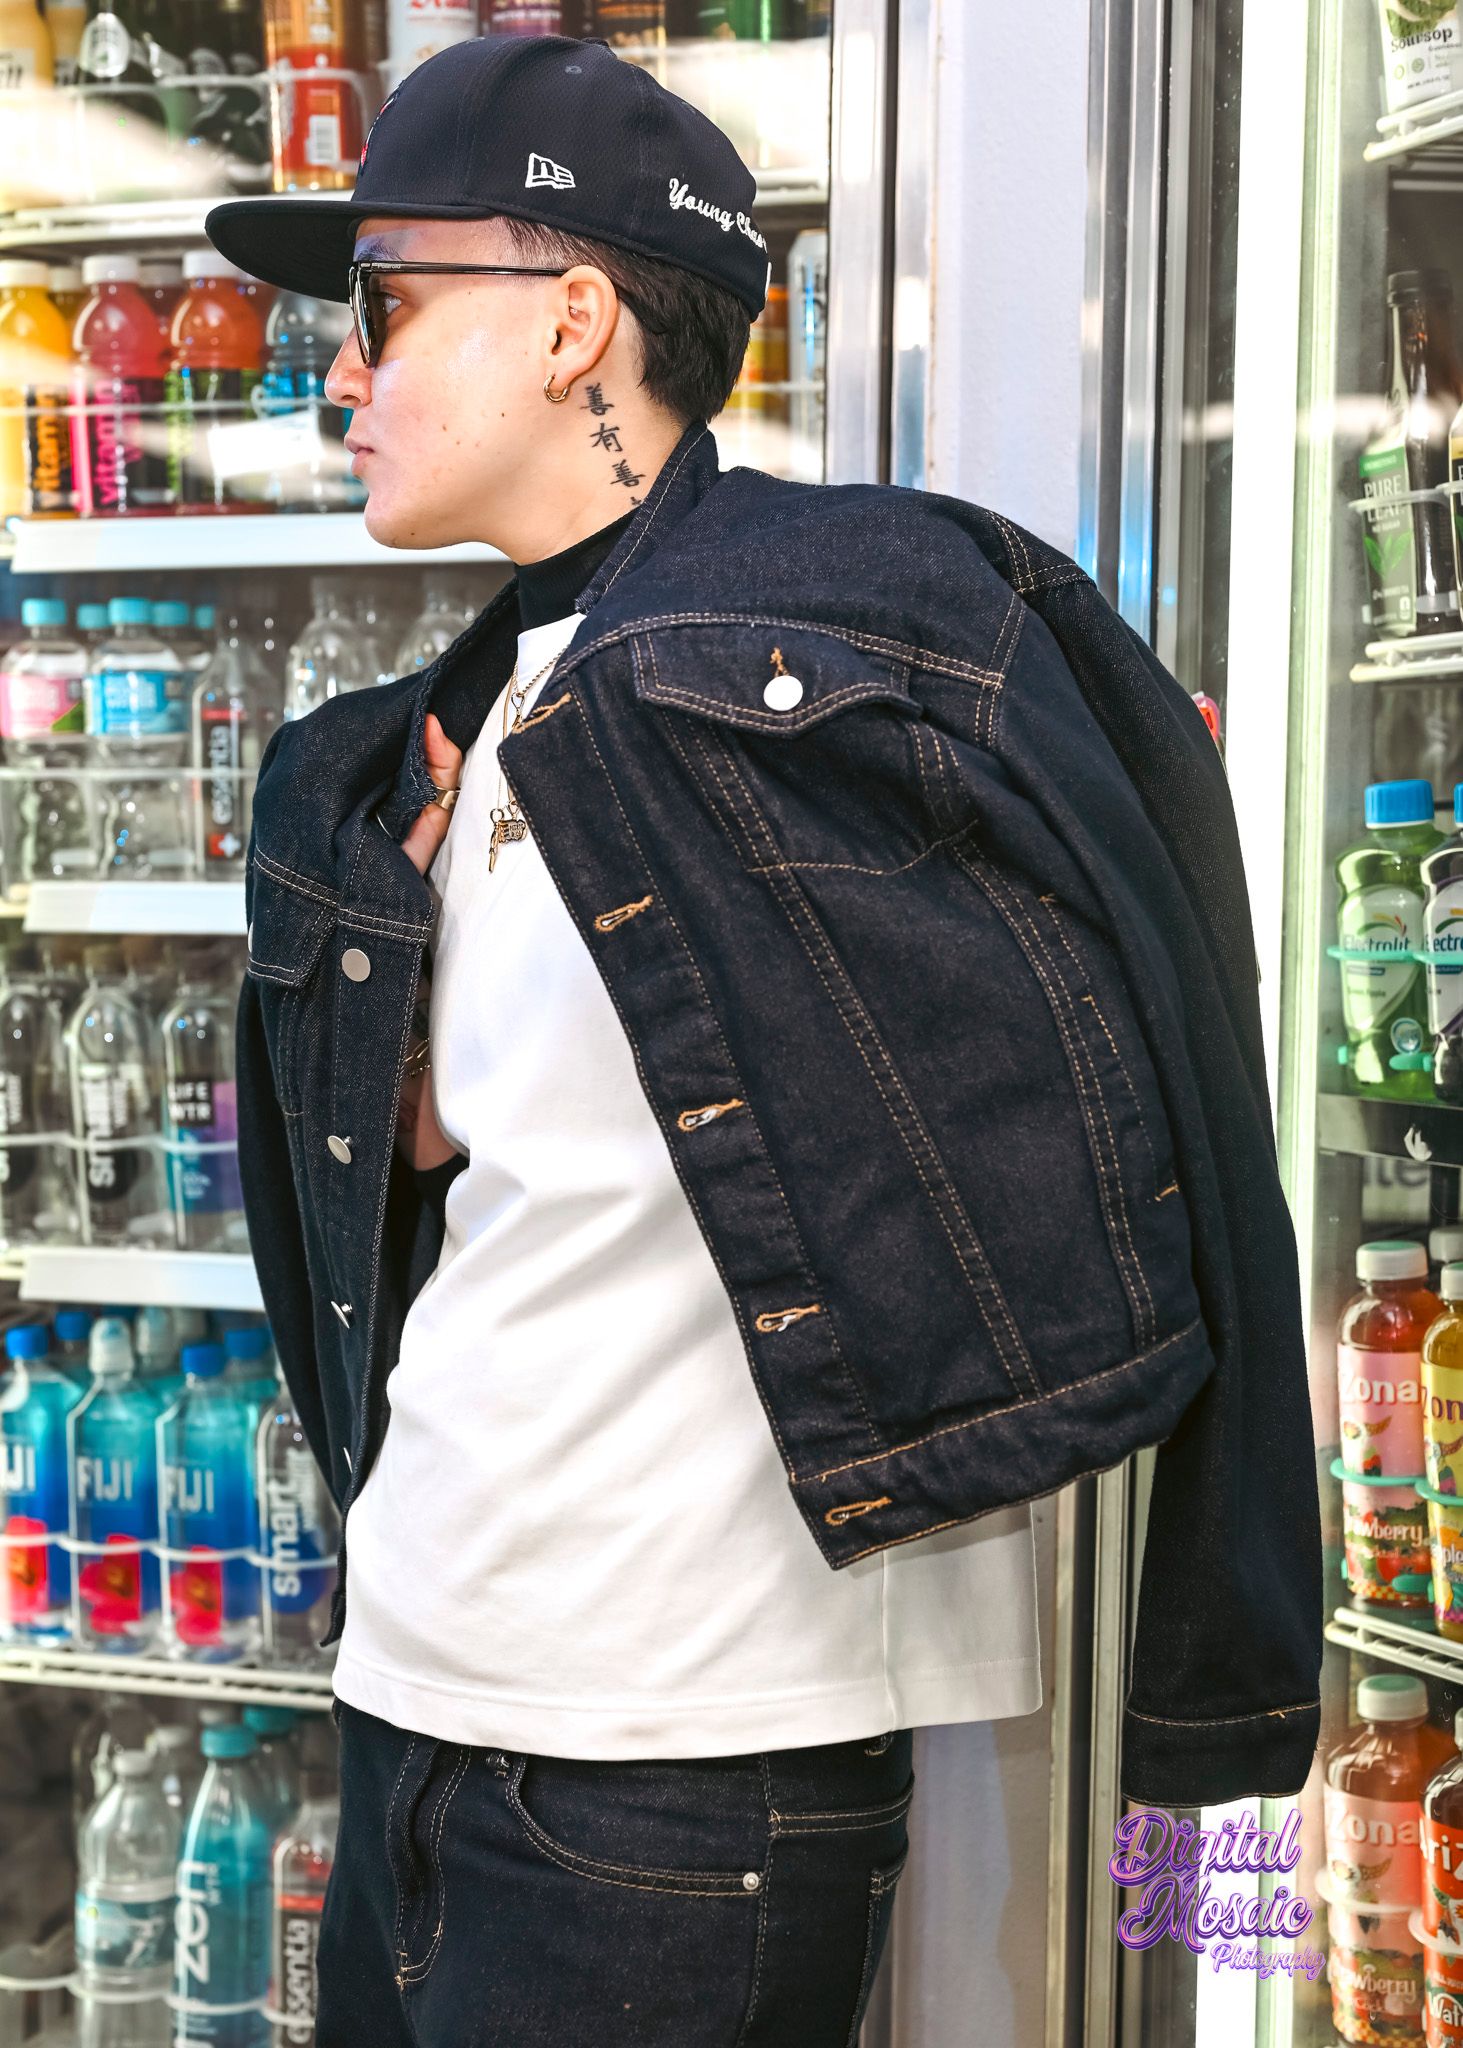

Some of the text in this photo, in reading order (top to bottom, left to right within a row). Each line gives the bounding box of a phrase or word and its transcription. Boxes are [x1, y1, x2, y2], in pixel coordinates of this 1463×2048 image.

[1391, 28, 1453, 53] Soursop
[669, 178, 735, 232] Young
[580, 382, 647, 506] 善有善
[1364, 474, 1403, 502] PURE
[76, 1456, 133, 1500] FIJI
[165, 1466, 214, 1513] FIJI
[268, 1478, 301, 1597] smart
